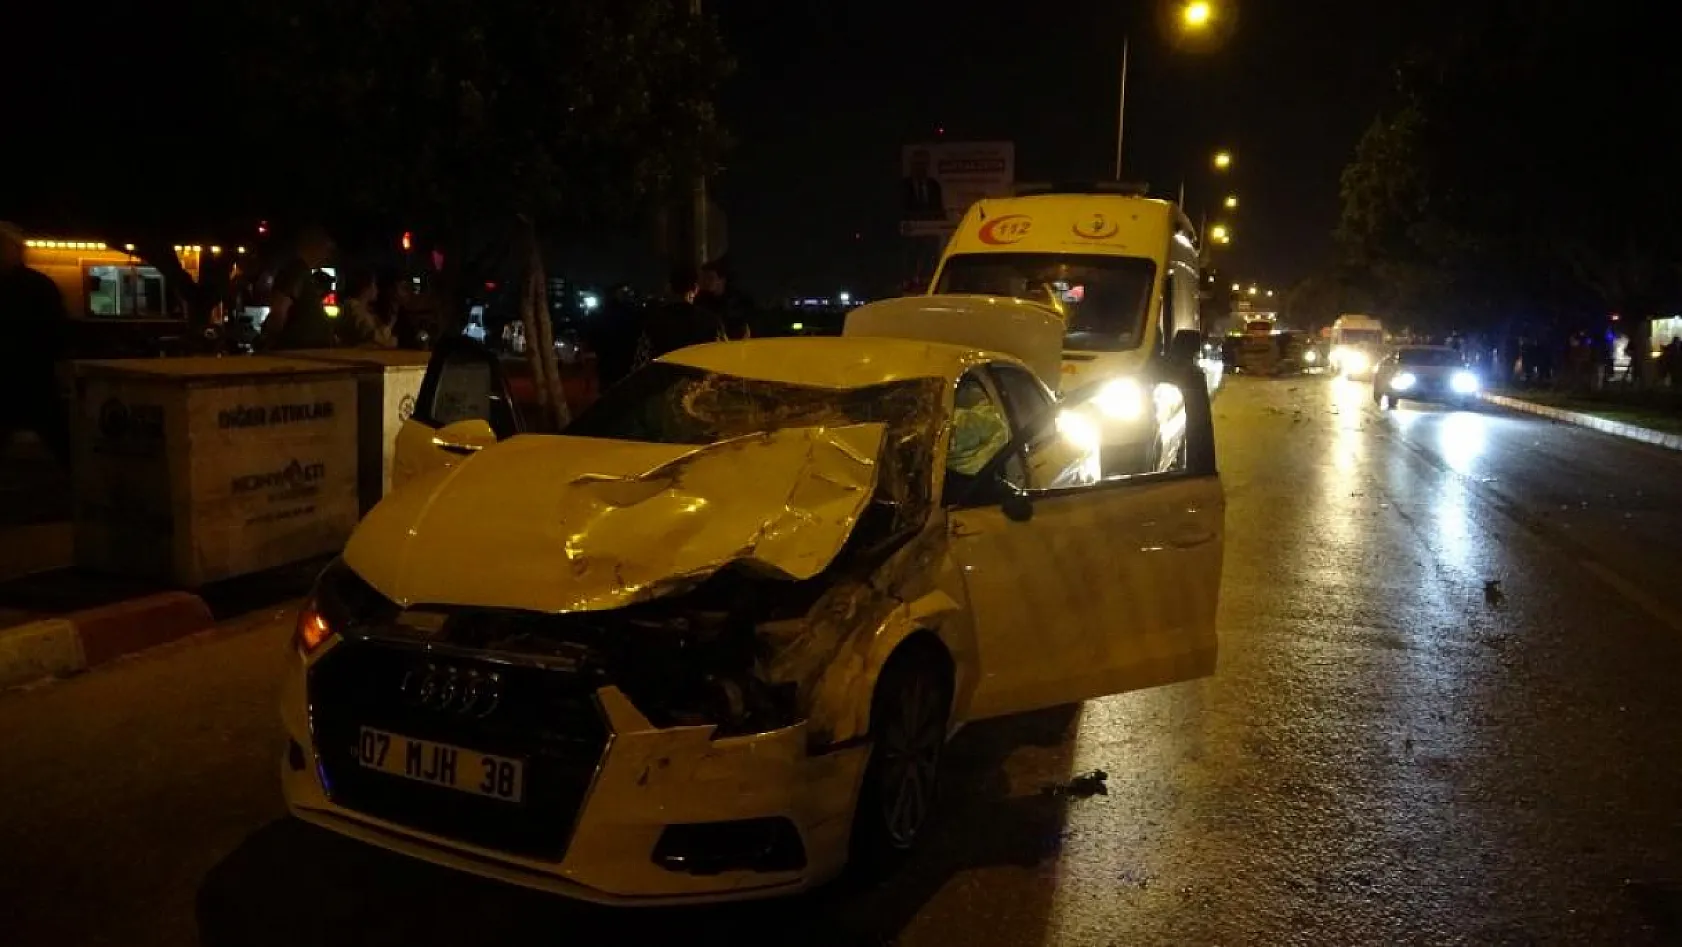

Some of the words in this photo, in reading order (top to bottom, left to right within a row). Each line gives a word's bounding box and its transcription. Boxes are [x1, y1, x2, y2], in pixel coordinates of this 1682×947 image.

[998, 220, 1031, 236] 112
[362, 731, 390, 767] 07
[406, 740, 457, 785] MJH
[480, 758, 514, 797] 38
